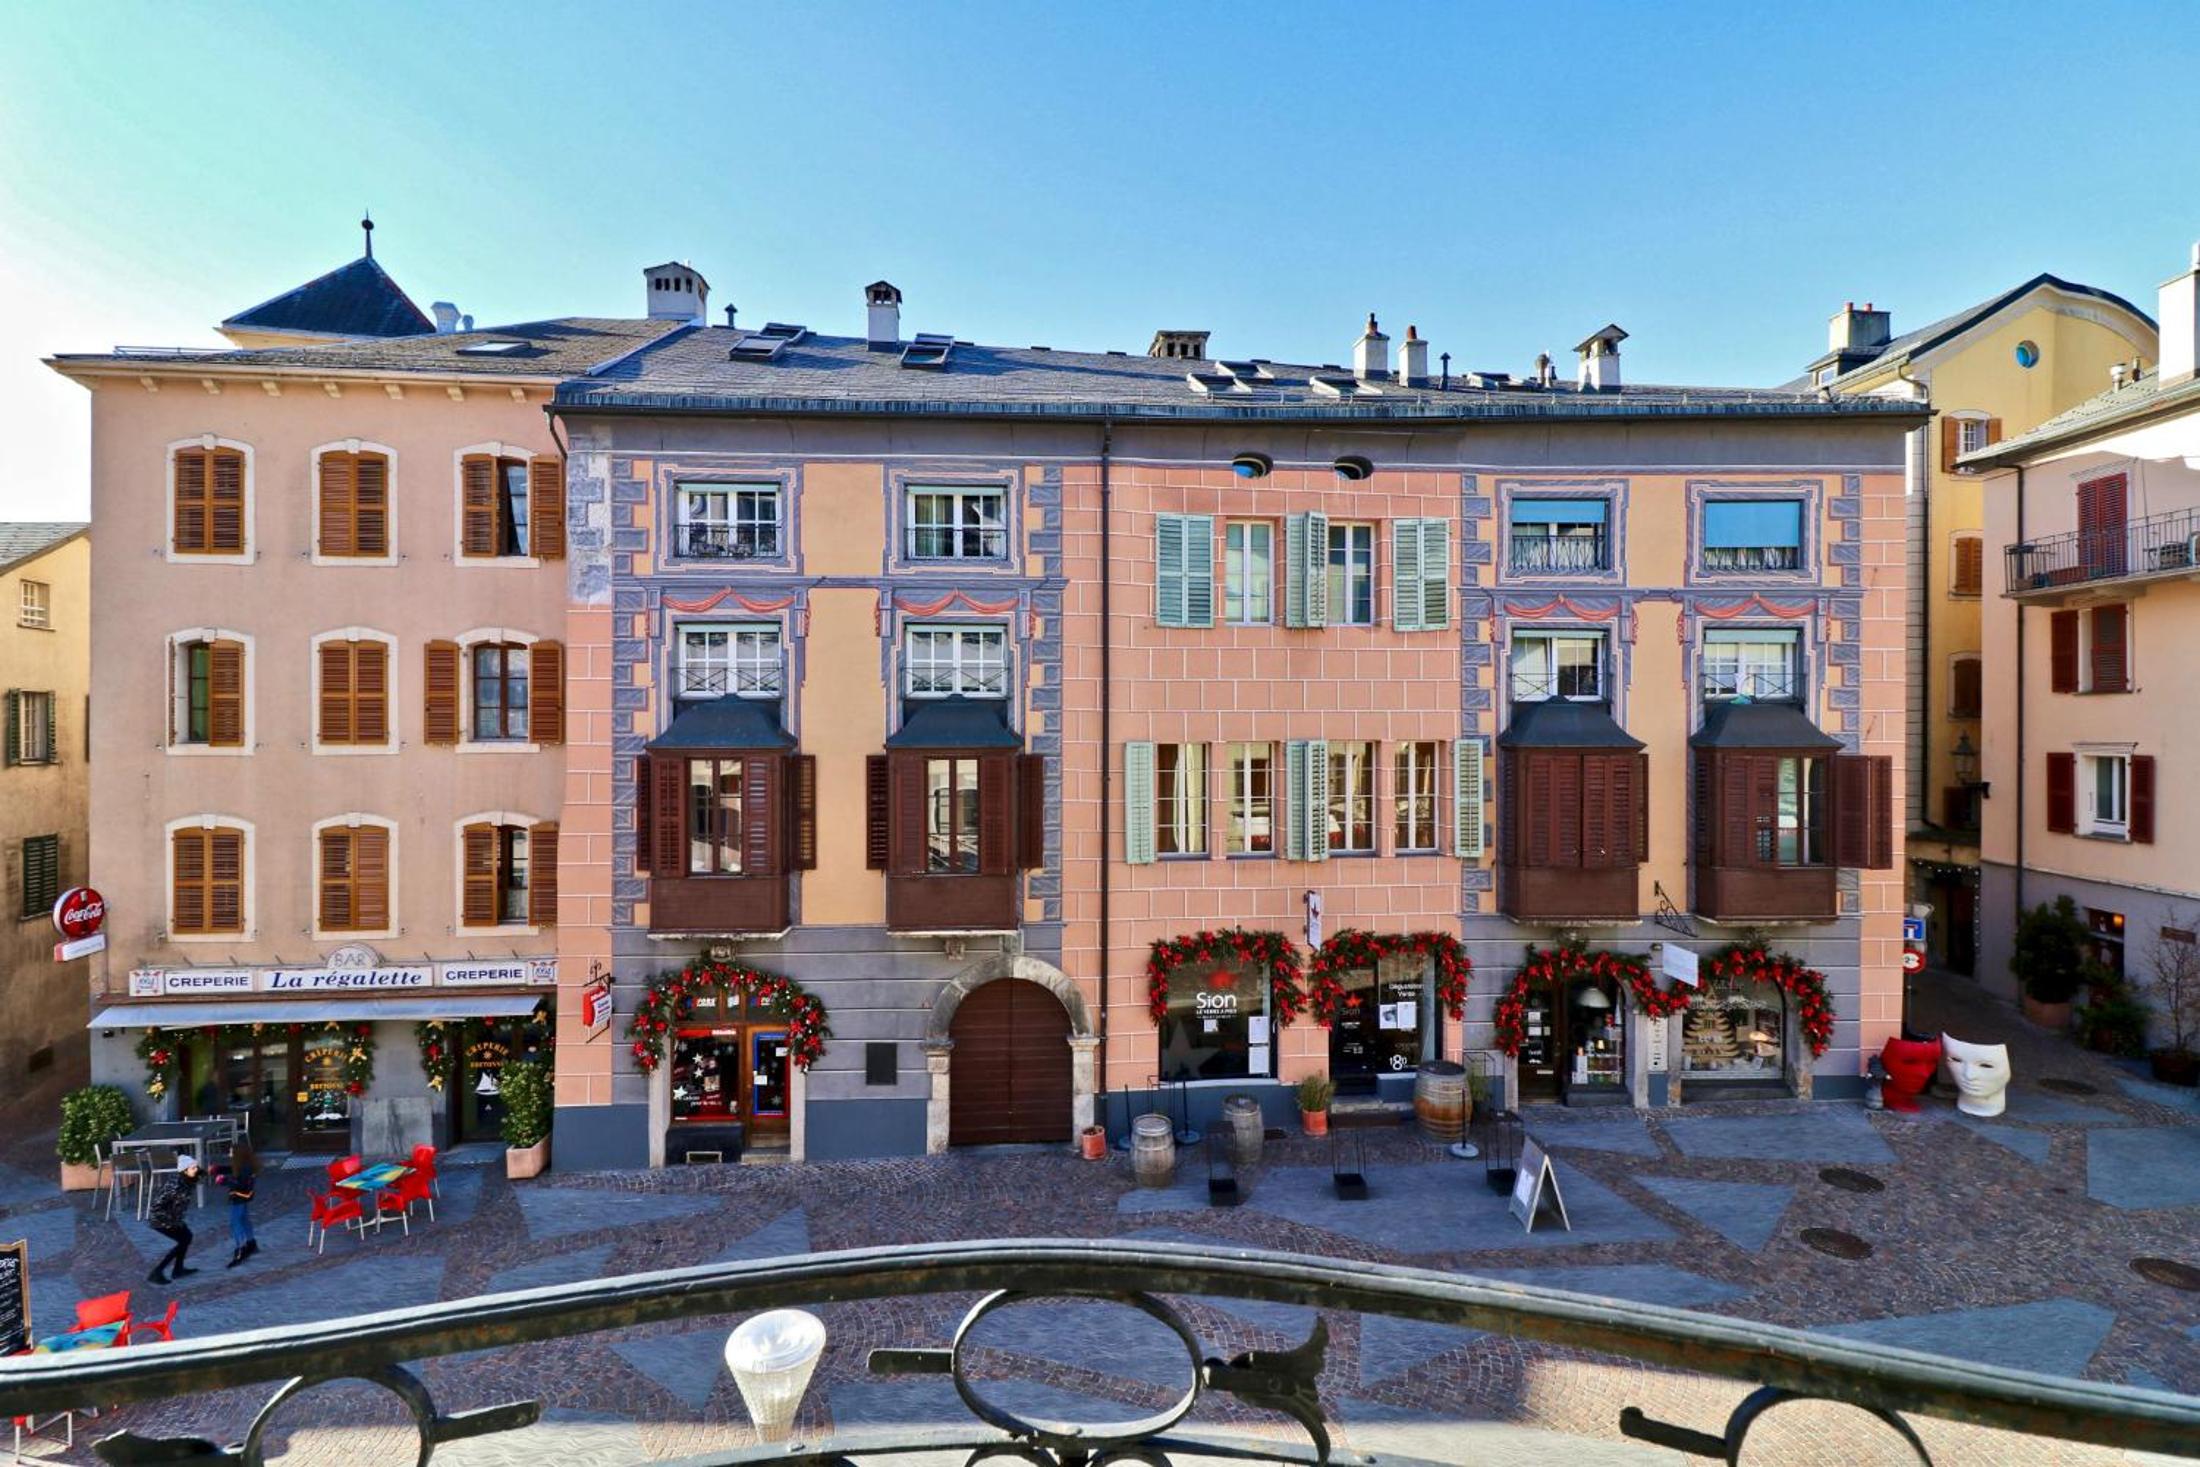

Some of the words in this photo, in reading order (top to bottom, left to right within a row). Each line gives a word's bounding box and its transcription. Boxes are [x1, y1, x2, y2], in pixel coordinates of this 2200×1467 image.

[334, 952, 366, 967] BAR
[169, 976, 248, 988] CREPERIE
[271, 972, 302, 988] La
[313, 970, 422, 988] régalette
[445, 969, 523, 980] CREPERIE
[1196, 992, 1237, 1009] Sion
